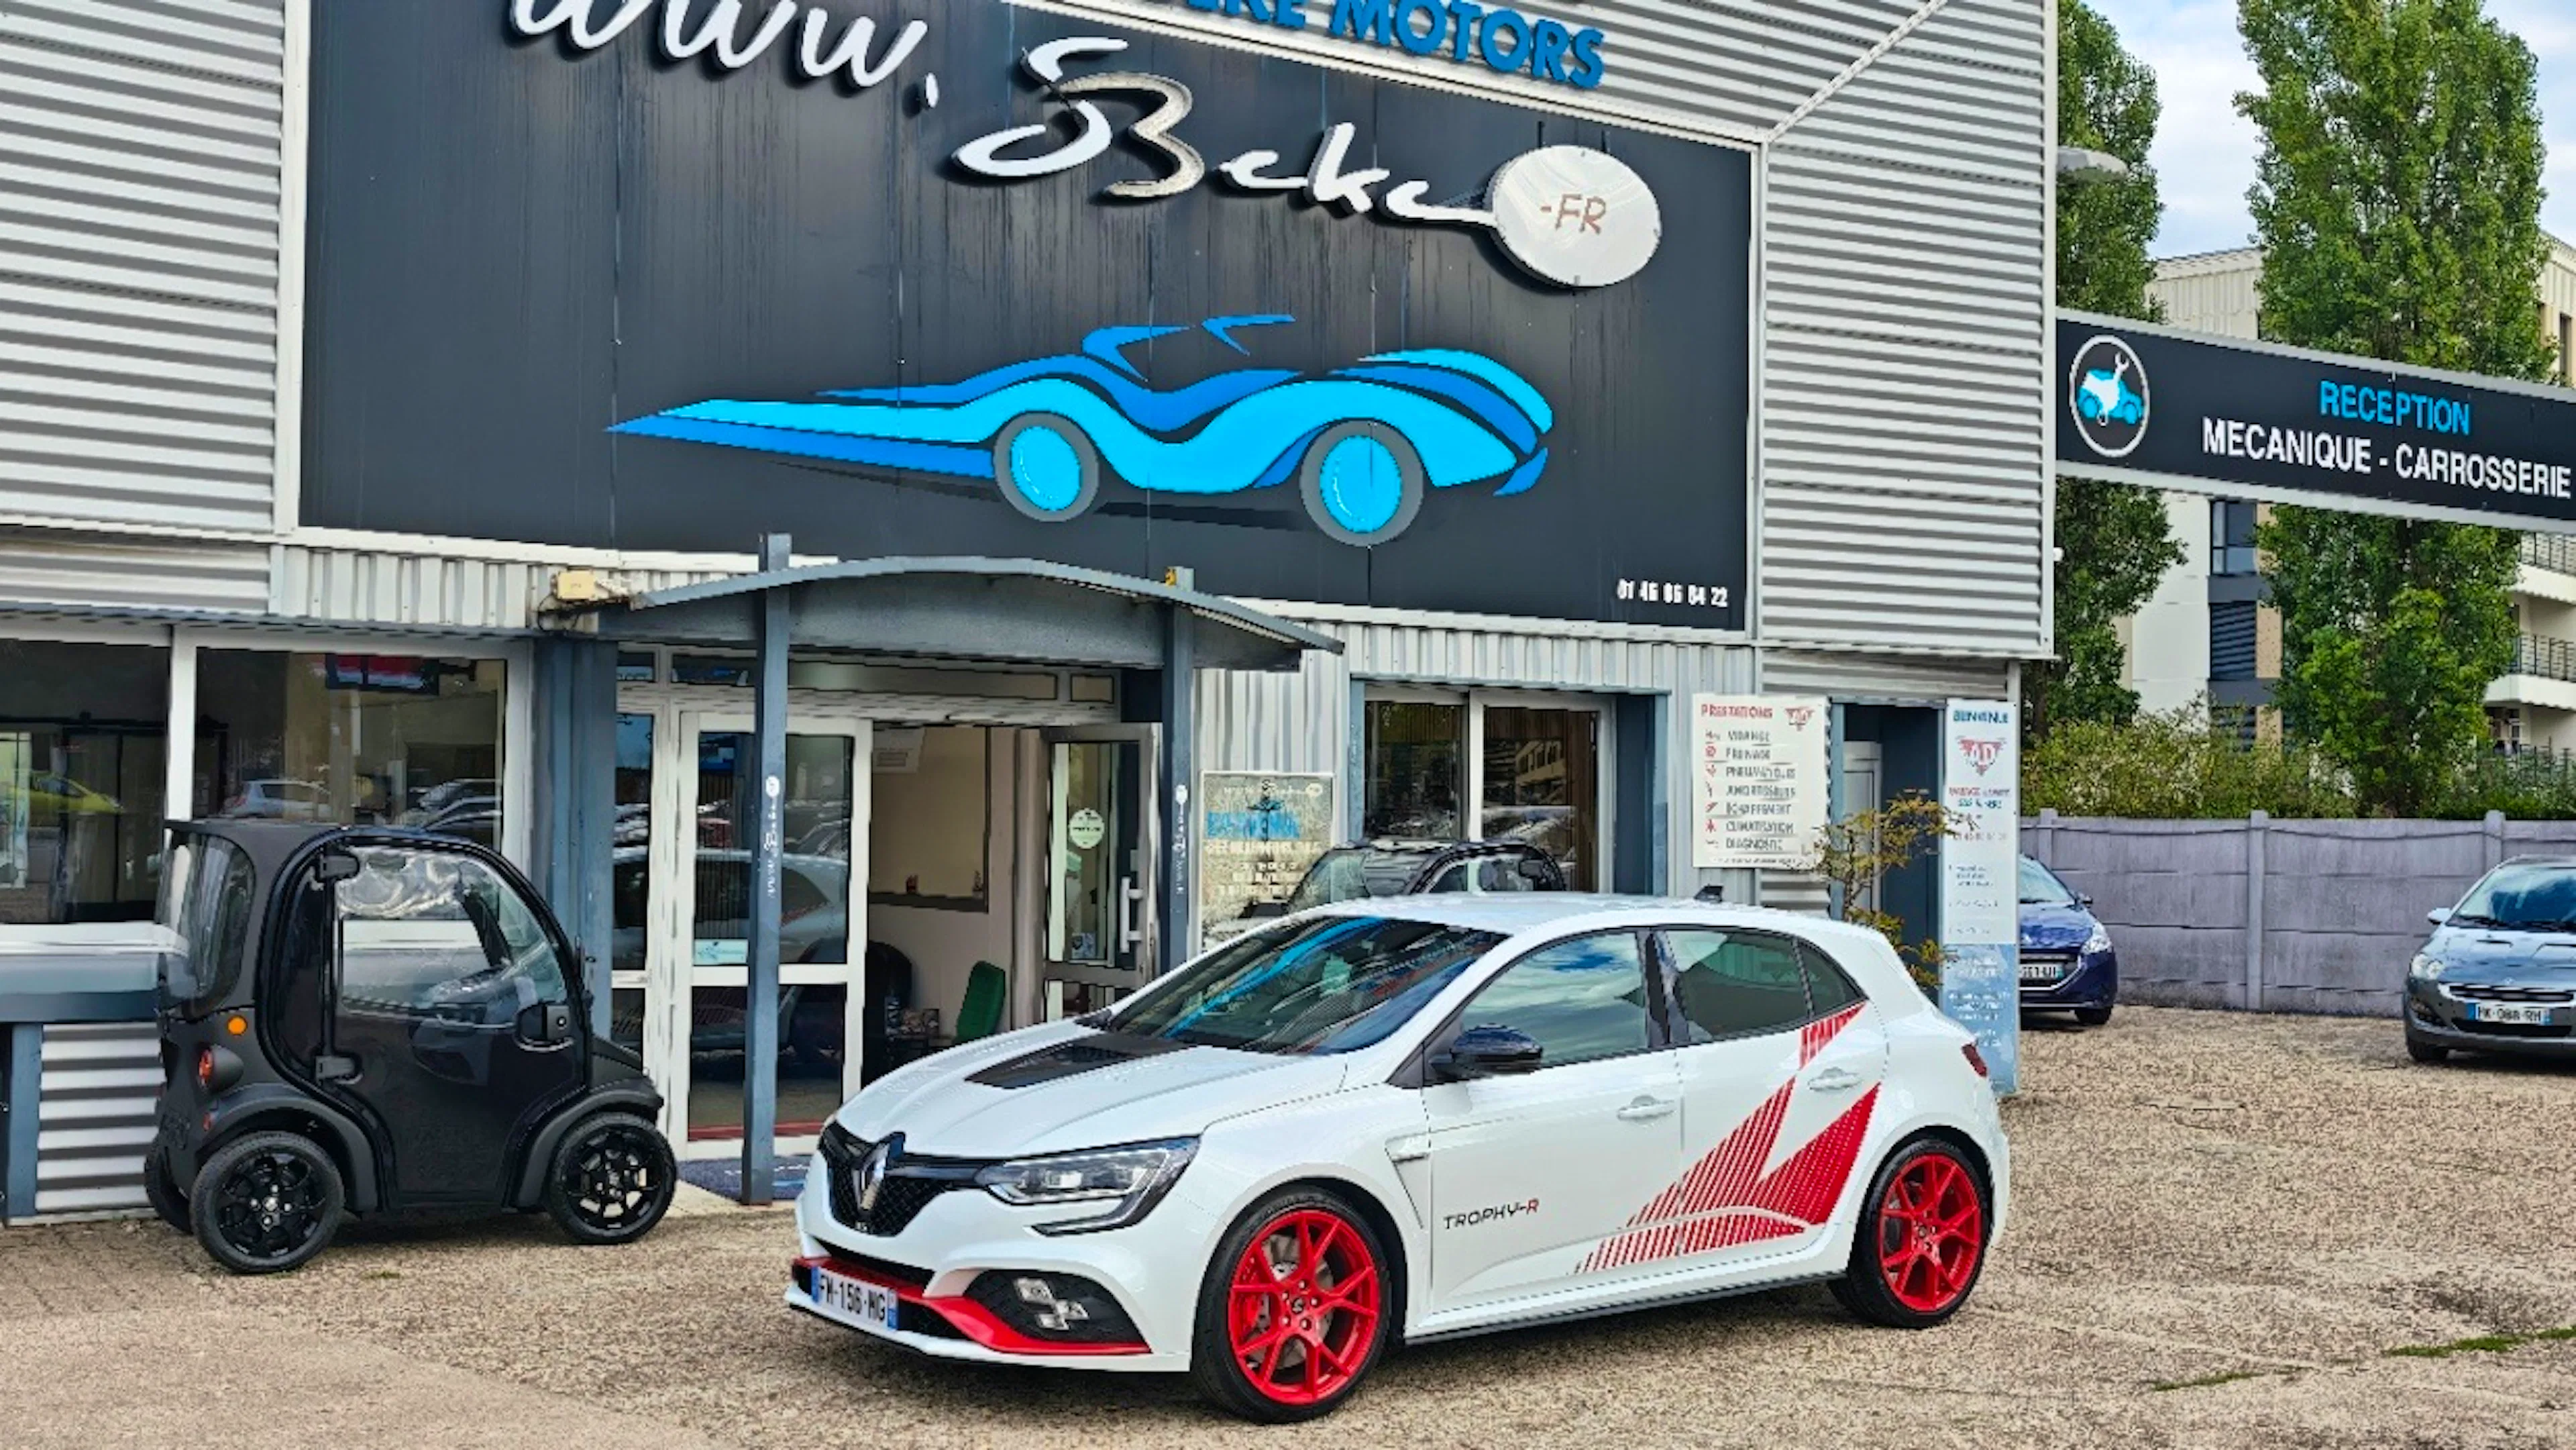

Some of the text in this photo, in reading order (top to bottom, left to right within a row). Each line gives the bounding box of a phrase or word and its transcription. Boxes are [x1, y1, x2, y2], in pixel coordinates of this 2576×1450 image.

[1330, 0, 1605, 89] MOTORS
[2319, 380, 2471, 435] RECEPTION
[2202, 416, 2372, 473] MECANIQUE
[2395, 443, 2573, 500] CARROSSERIE
[1711, 586, 1728, 608] 22
[1444, 1198, 1540, 1229] TROPHY-R
